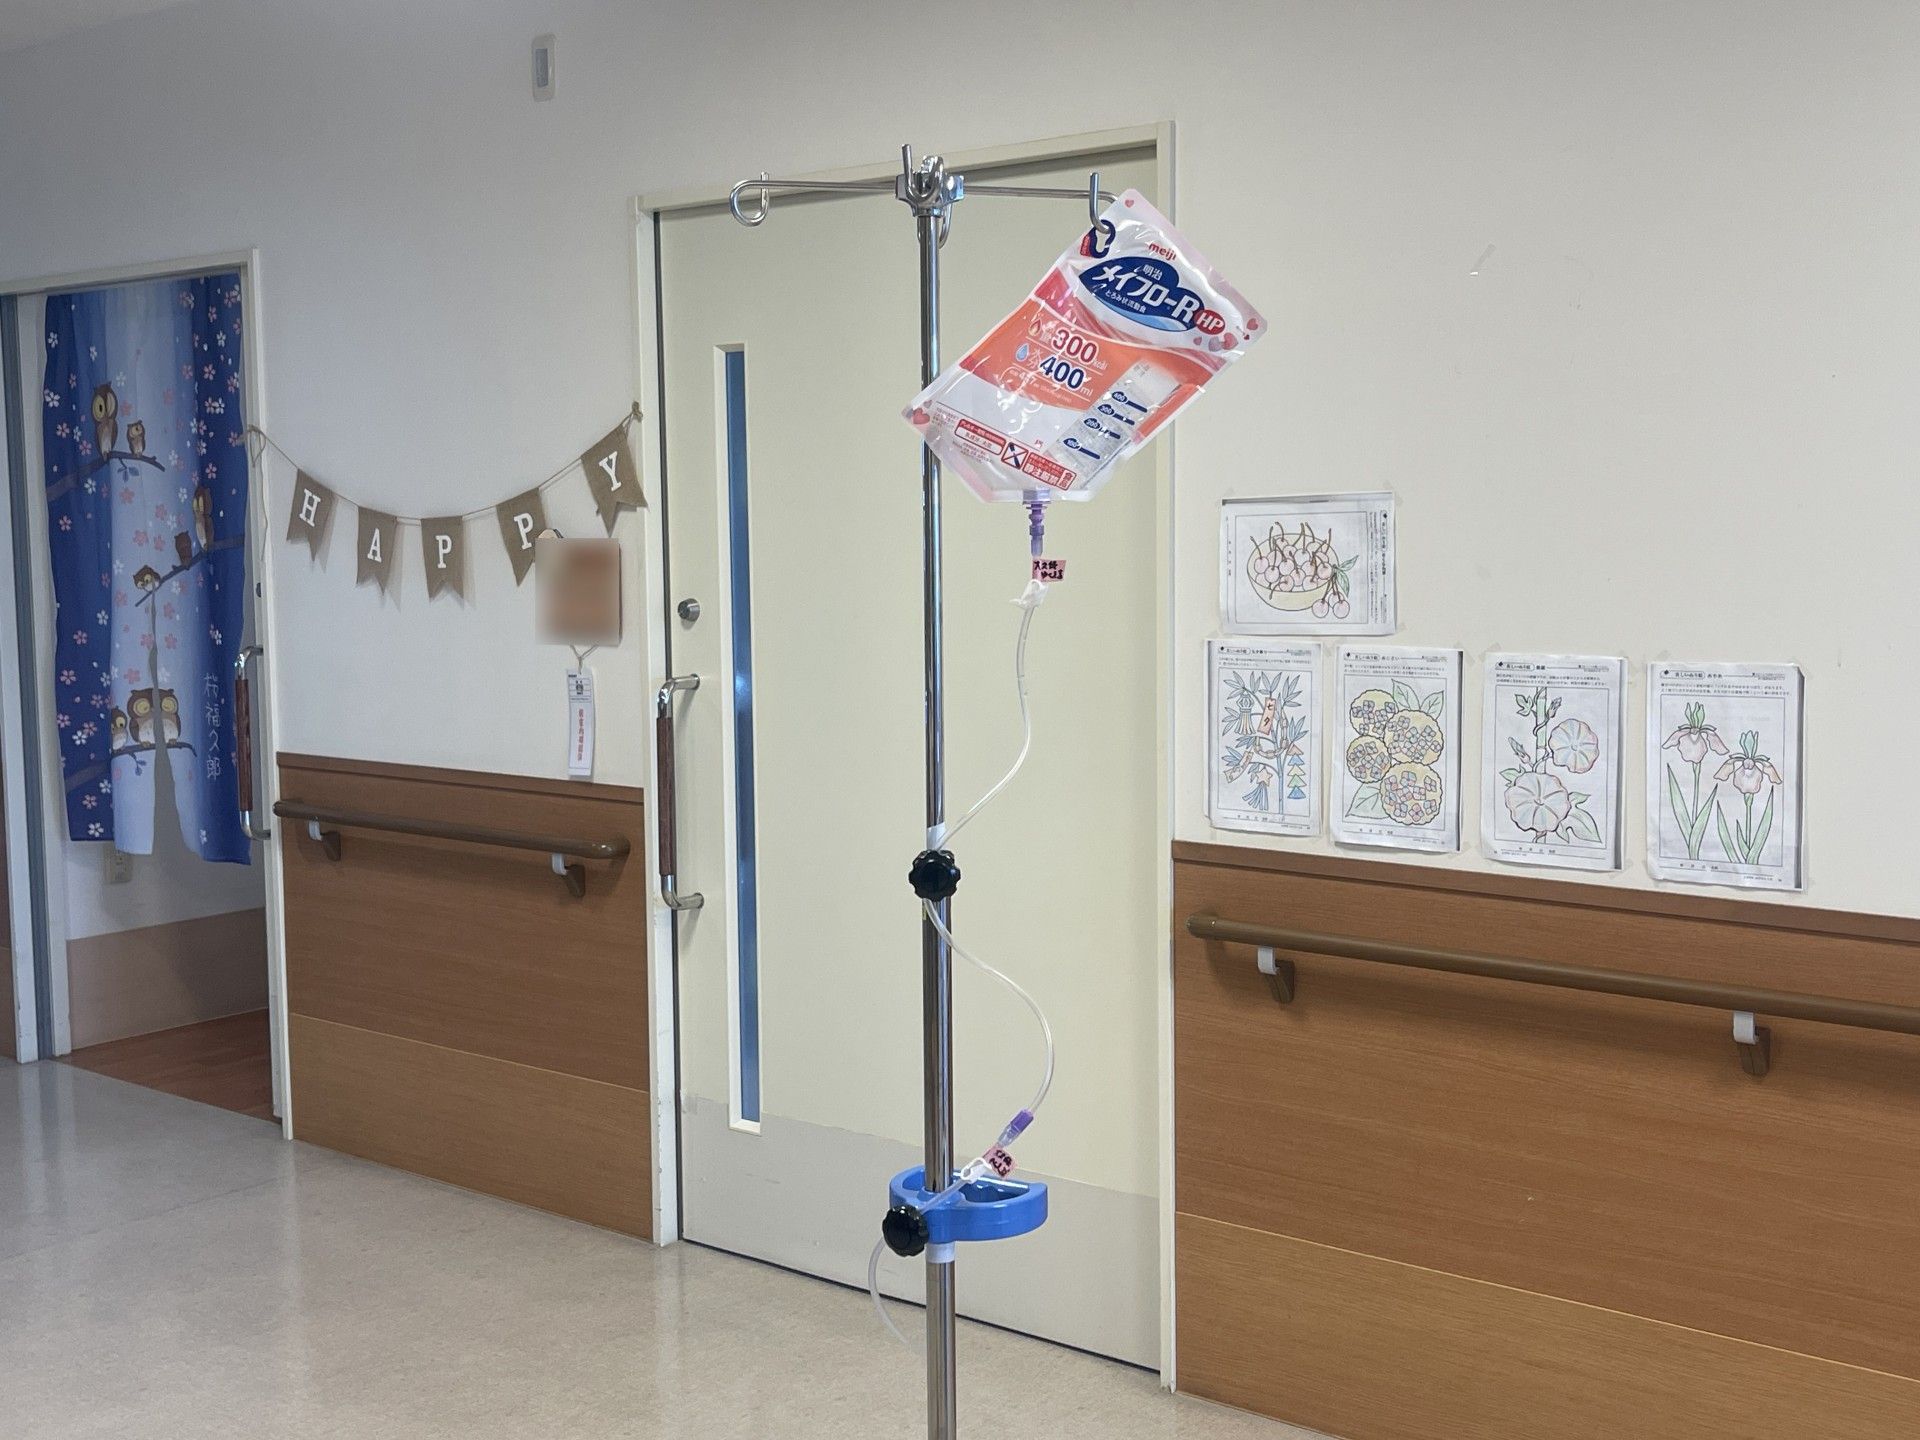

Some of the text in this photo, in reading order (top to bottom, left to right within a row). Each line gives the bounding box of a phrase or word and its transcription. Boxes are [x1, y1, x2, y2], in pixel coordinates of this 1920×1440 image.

[1148, 241, 1177, 261] meiji
[1143, 264, 1163, 281] 明治
[1196, 311, 1224, 331] HP
[1052, 329, 1098, 363] 300
[1039, 355, 1085, 390] 400
